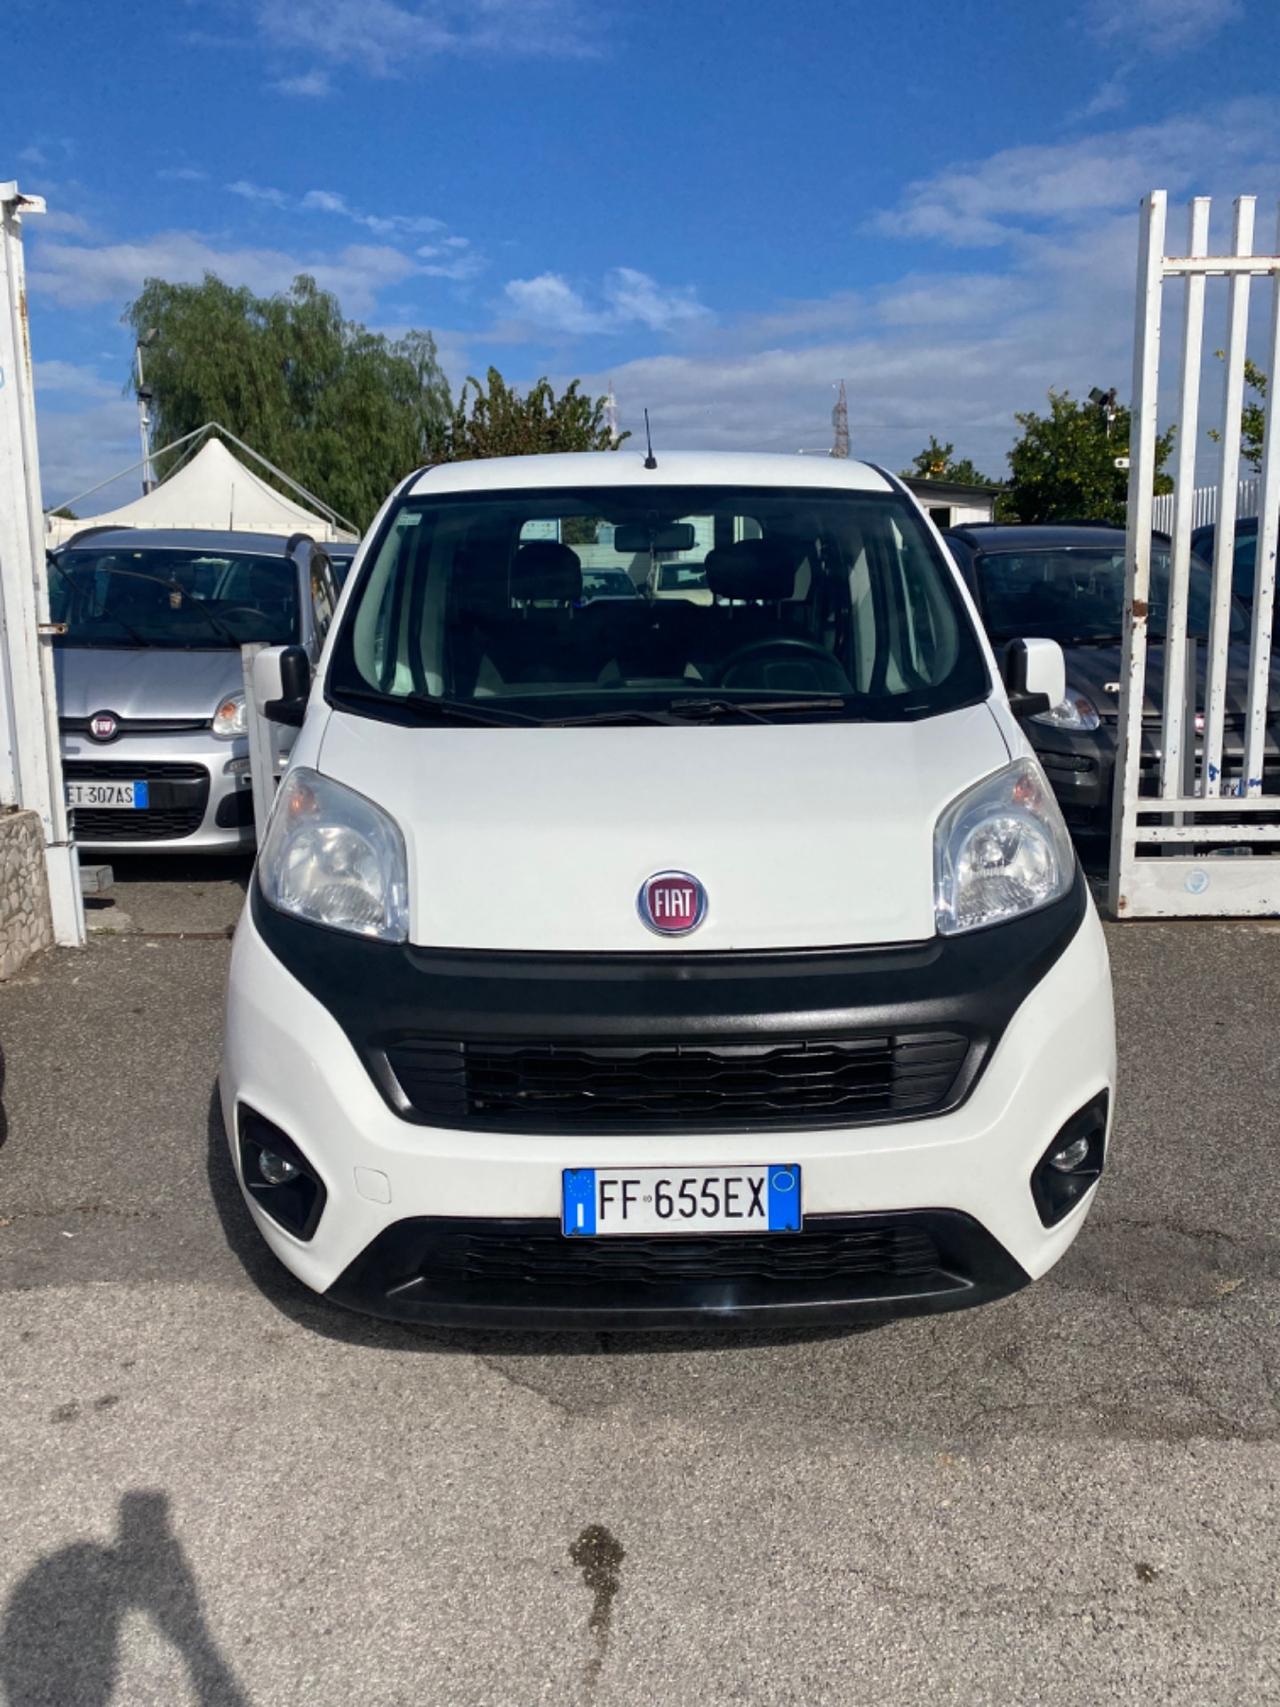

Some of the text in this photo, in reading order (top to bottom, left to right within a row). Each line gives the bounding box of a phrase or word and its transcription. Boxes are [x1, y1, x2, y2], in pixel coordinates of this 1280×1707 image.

[88, 786, 133, 804] 307AS
[654, 888, 693, 918] FIAT
[599, 1179, 641, 1220] FF
[654, 1177, 766, 1219] 655EX
